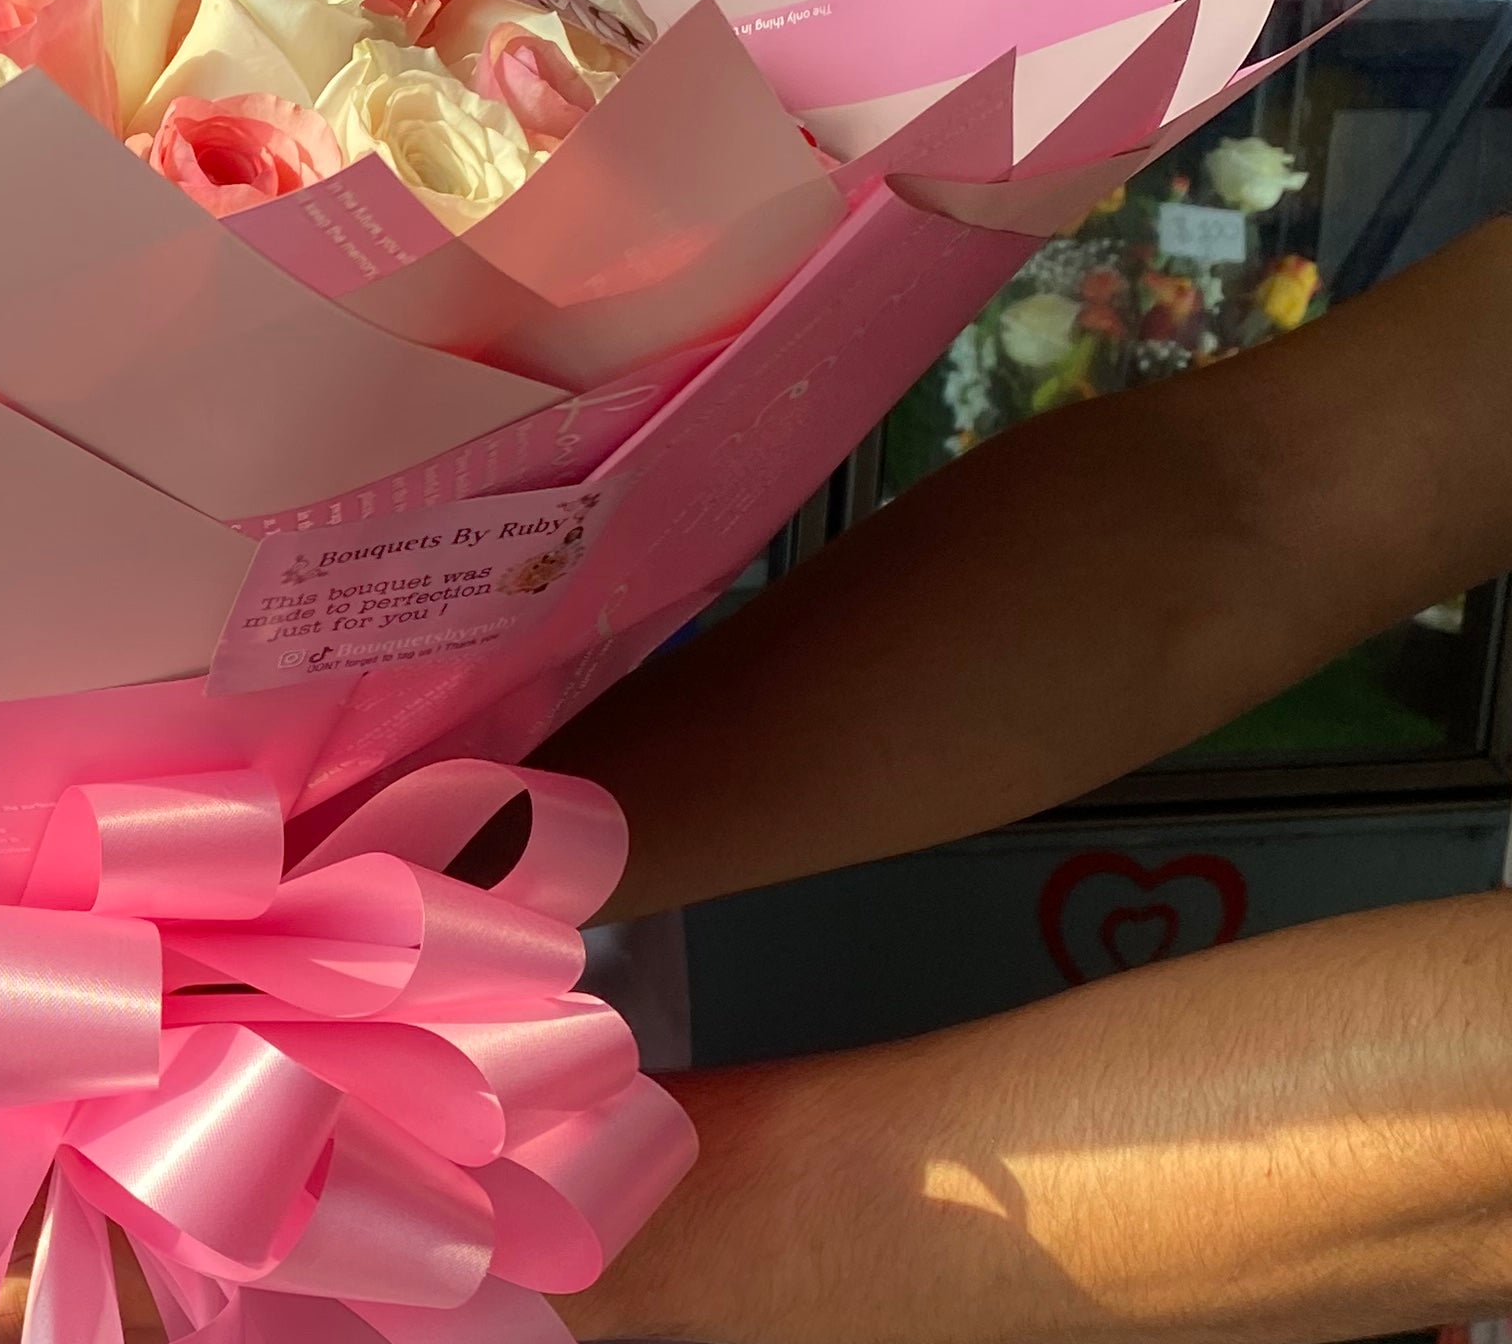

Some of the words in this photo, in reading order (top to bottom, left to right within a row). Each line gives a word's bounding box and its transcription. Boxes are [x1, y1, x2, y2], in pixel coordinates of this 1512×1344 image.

[741, 24, 753, 35] in
[755, 16, 785, 31] thing
[787, 9, 811, 25] only
[812, 4, 833, 17] The
[317, 533, 443, 568] Bouquets
[451, 526, 492, 551] By
[497, 515, 571, 541] Ruby
[242, 608, 320, 629] made
[325, 601, 354, 616] to
[358, 582, 493, 616] perfection
[261, 593, 317, 611] This
[327, 574, 432, 603] bouquet
[442, 565, 493, 584] was
[267, 620, 322, 643] just
[332, 613, 374, 632] for
[381, 607, 429, 631] you
[439, 603, 450, 617] !
[335, 612, 521, 660] Bouquetsbyruby
